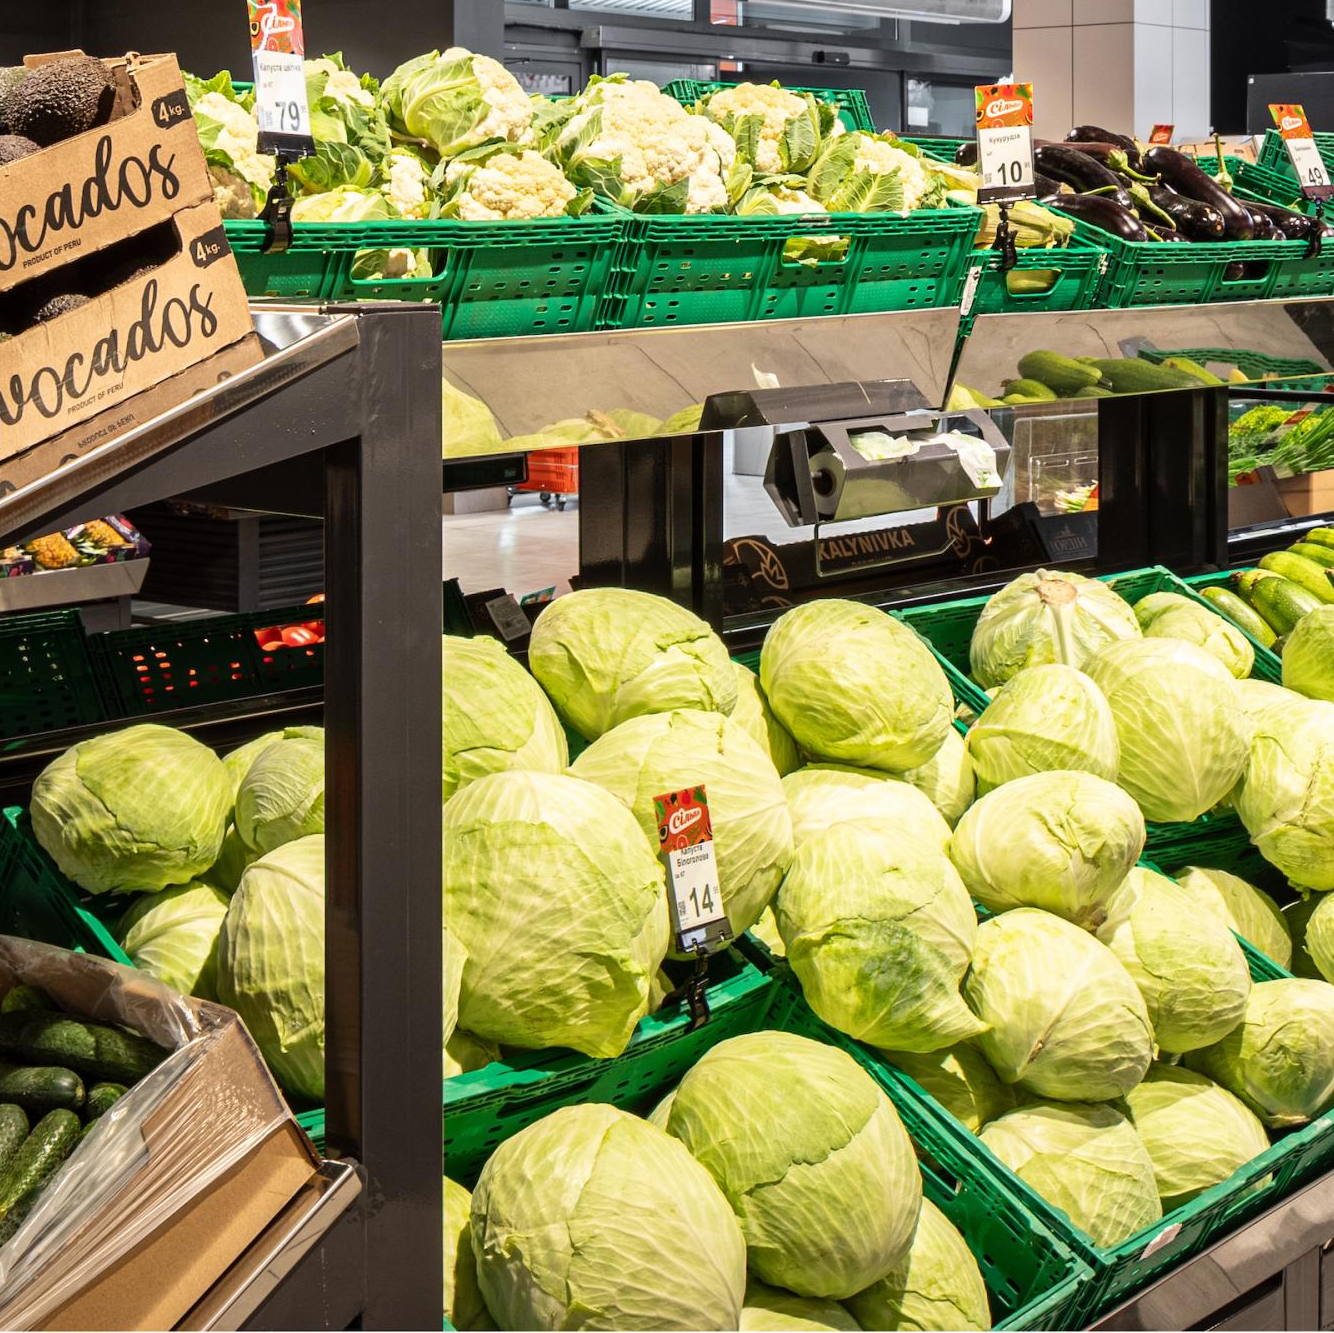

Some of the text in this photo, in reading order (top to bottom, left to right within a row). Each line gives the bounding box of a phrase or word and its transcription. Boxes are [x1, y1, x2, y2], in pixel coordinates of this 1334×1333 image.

[275, 101, 301, 132] 79
[997, 161, 1022, 185] 10
[1308, 167, 1323, 186] 49
[22, 237, 82, 269] PRODUCT OF PERU
[67, 381, 124, 415] PRODUCT OF PERU
[818, 529, 916, 561] KALYNIVKA
[689, 883, 713, 918] 14
